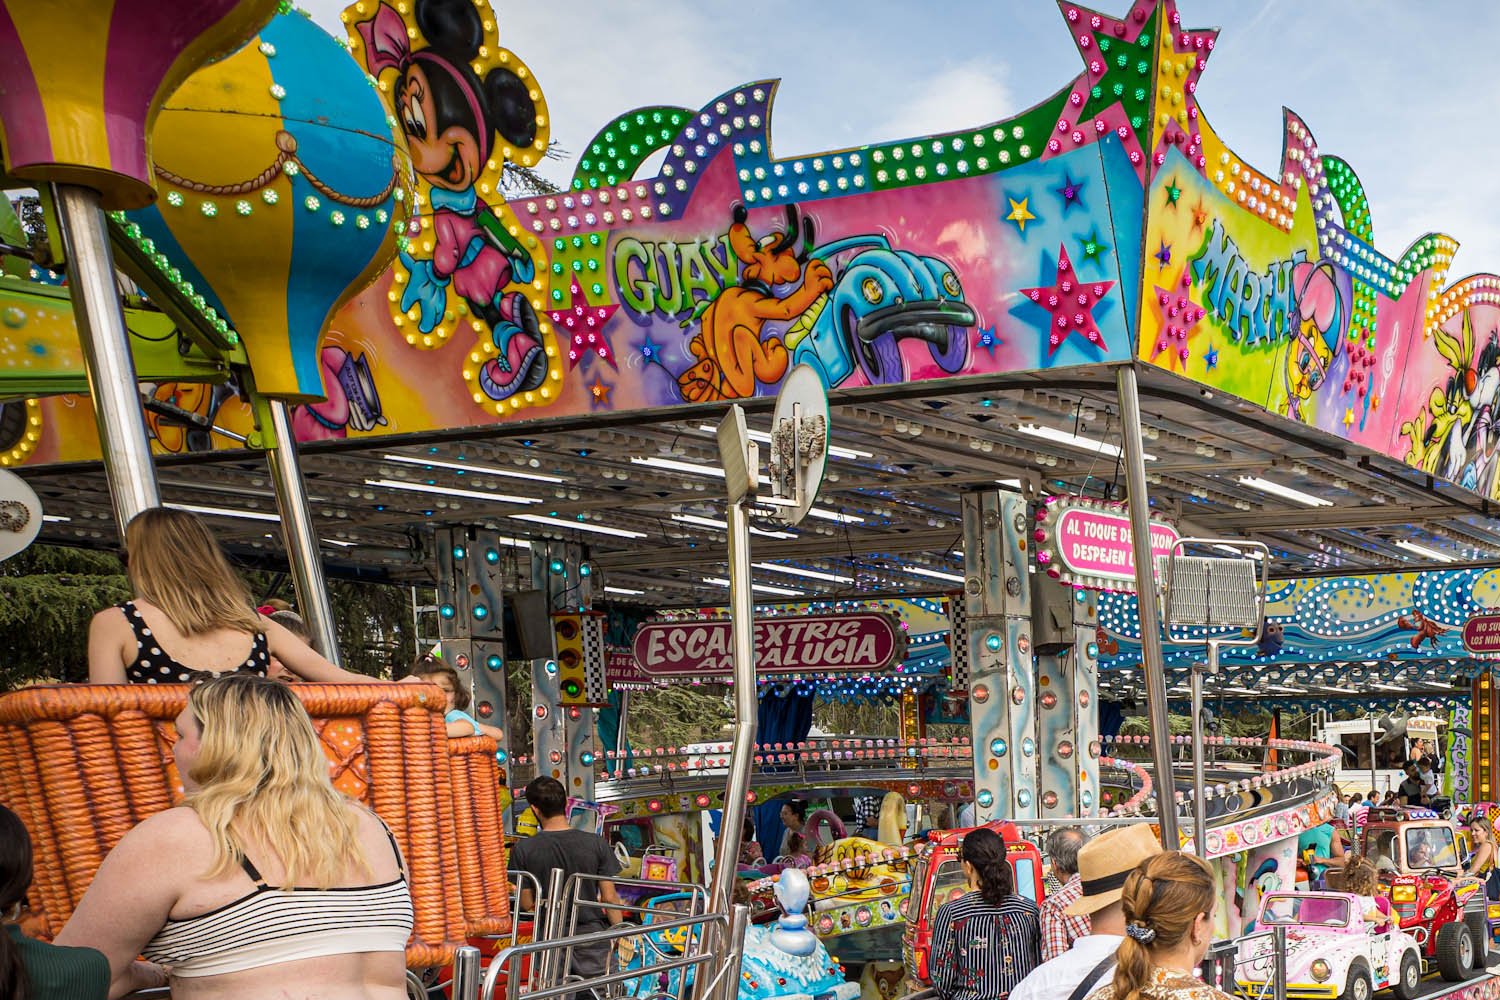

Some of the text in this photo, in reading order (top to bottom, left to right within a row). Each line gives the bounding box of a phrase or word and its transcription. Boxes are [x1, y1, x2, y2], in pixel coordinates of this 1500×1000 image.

[1192, 218, 1307, 345] MARCH
[1067, 518, 1080, 535] AL
[1084, 521, 1117, 541] TOQUE
[1072, 543, 1126, 566] DESPEJEN
[1476, 622, 1487, 632] NO
[1471, 636, 1484, 645] LOS
